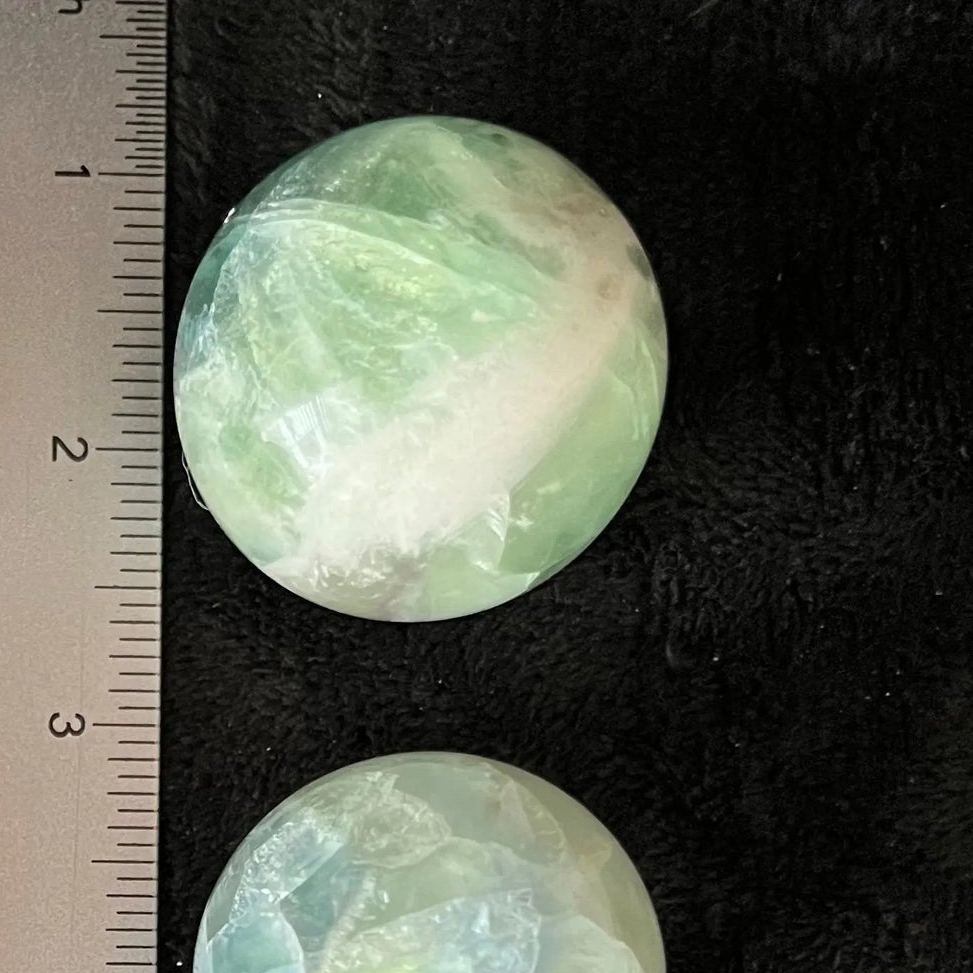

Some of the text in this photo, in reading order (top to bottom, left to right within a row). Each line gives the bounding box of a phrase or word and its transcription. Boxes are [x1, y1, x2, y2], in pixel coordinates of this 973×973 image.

[55, 165, 90, 178] 1
[52, 436, 88, 463] 2
[49, 713, 85, 738] 3
